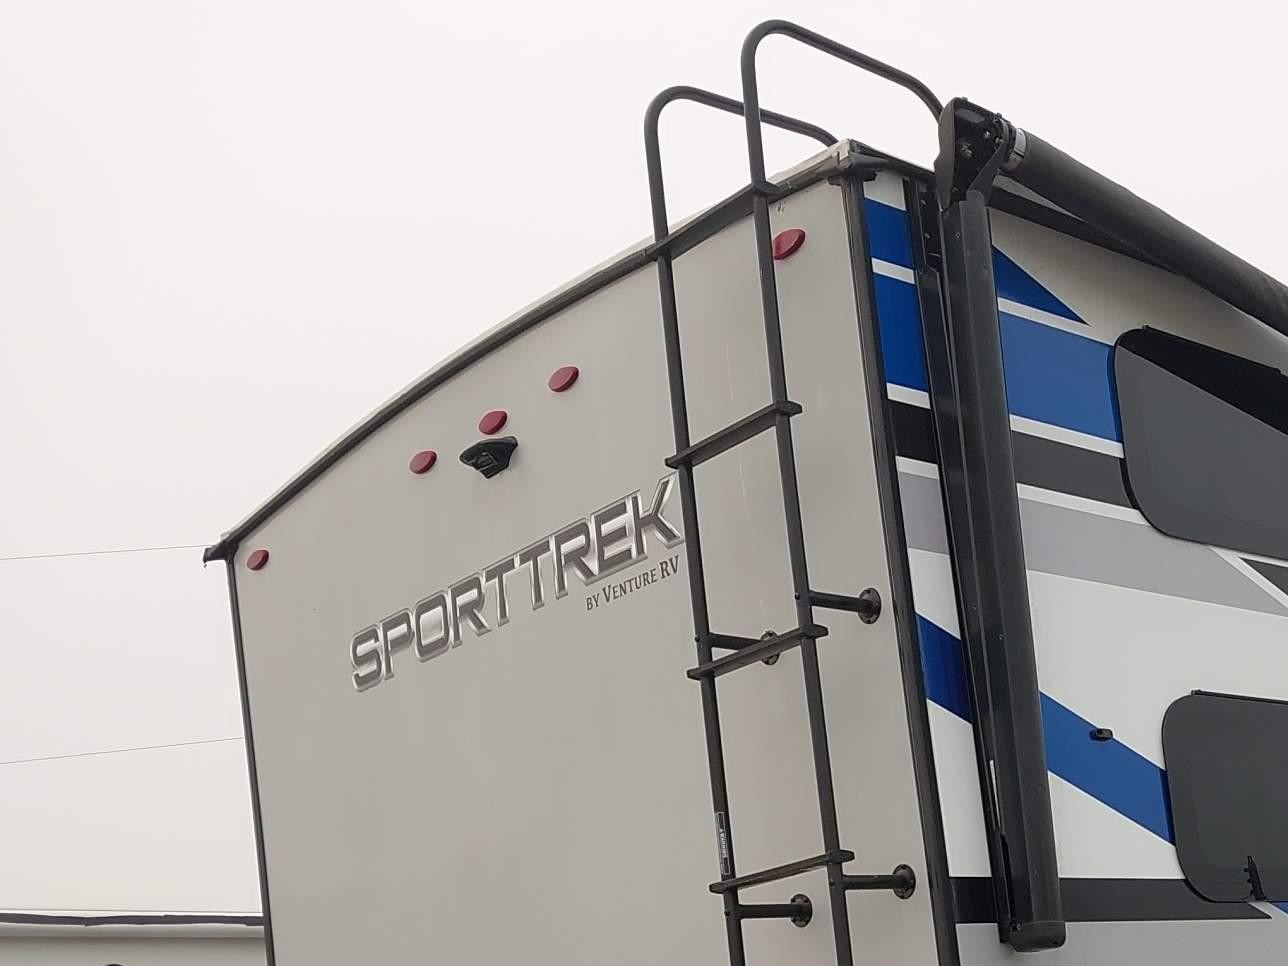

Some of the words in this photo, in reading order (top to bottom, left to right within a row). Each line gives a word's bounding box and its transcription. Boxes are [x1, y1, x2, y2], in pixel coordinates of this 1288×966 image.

[350, 471, 685, 692] SPORTTREK
[586, 593, 600, 611] BY
[659, 554, 680, 580] RV
